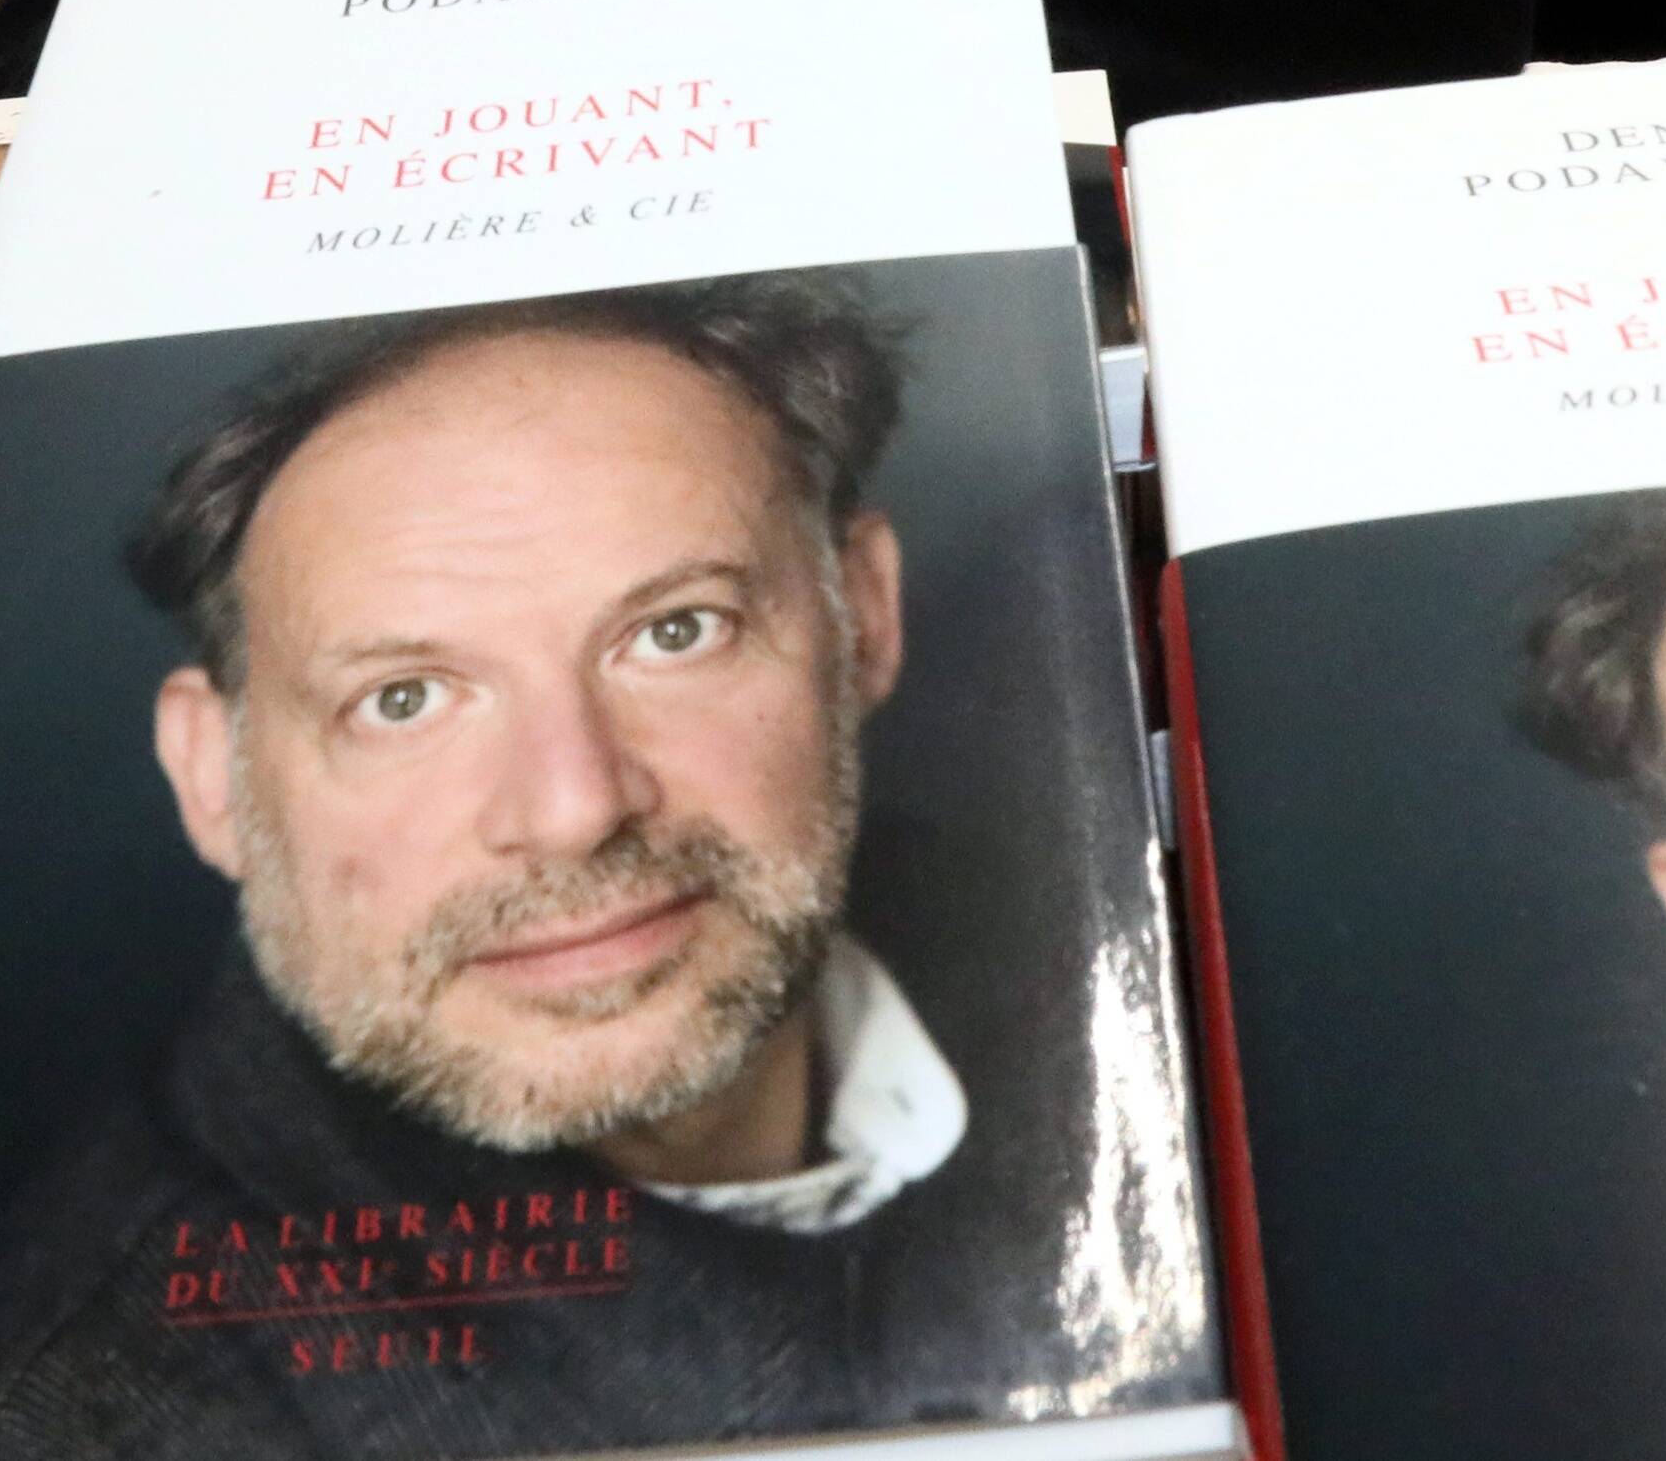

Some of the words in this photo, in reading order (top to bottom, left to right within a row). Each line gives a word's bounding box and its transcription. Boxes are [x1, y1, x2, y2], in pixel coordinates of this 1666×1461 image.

[308, 114, 397, 150] EN
[434, 78, 732, 138] JOUANT,
[262, 164, 350, 200] EN
[392, 118, 771, 189] ÉCRIVANT
[305, 210, 543, 254] MOLIÈRE
[569, 204, 597, 228] &
[629, 188, 716, 221] CIE
[1495, 282, 1593, 317] EN
[1472, 329, 1571, 364] EN
[174, 1220, 249, 1259] LA
[279, 1186, 633, 1249] LIBRAIRIE
[166, 1269, 237, 1309] DU
[290, 1326, 491, 1377] SEUIL
